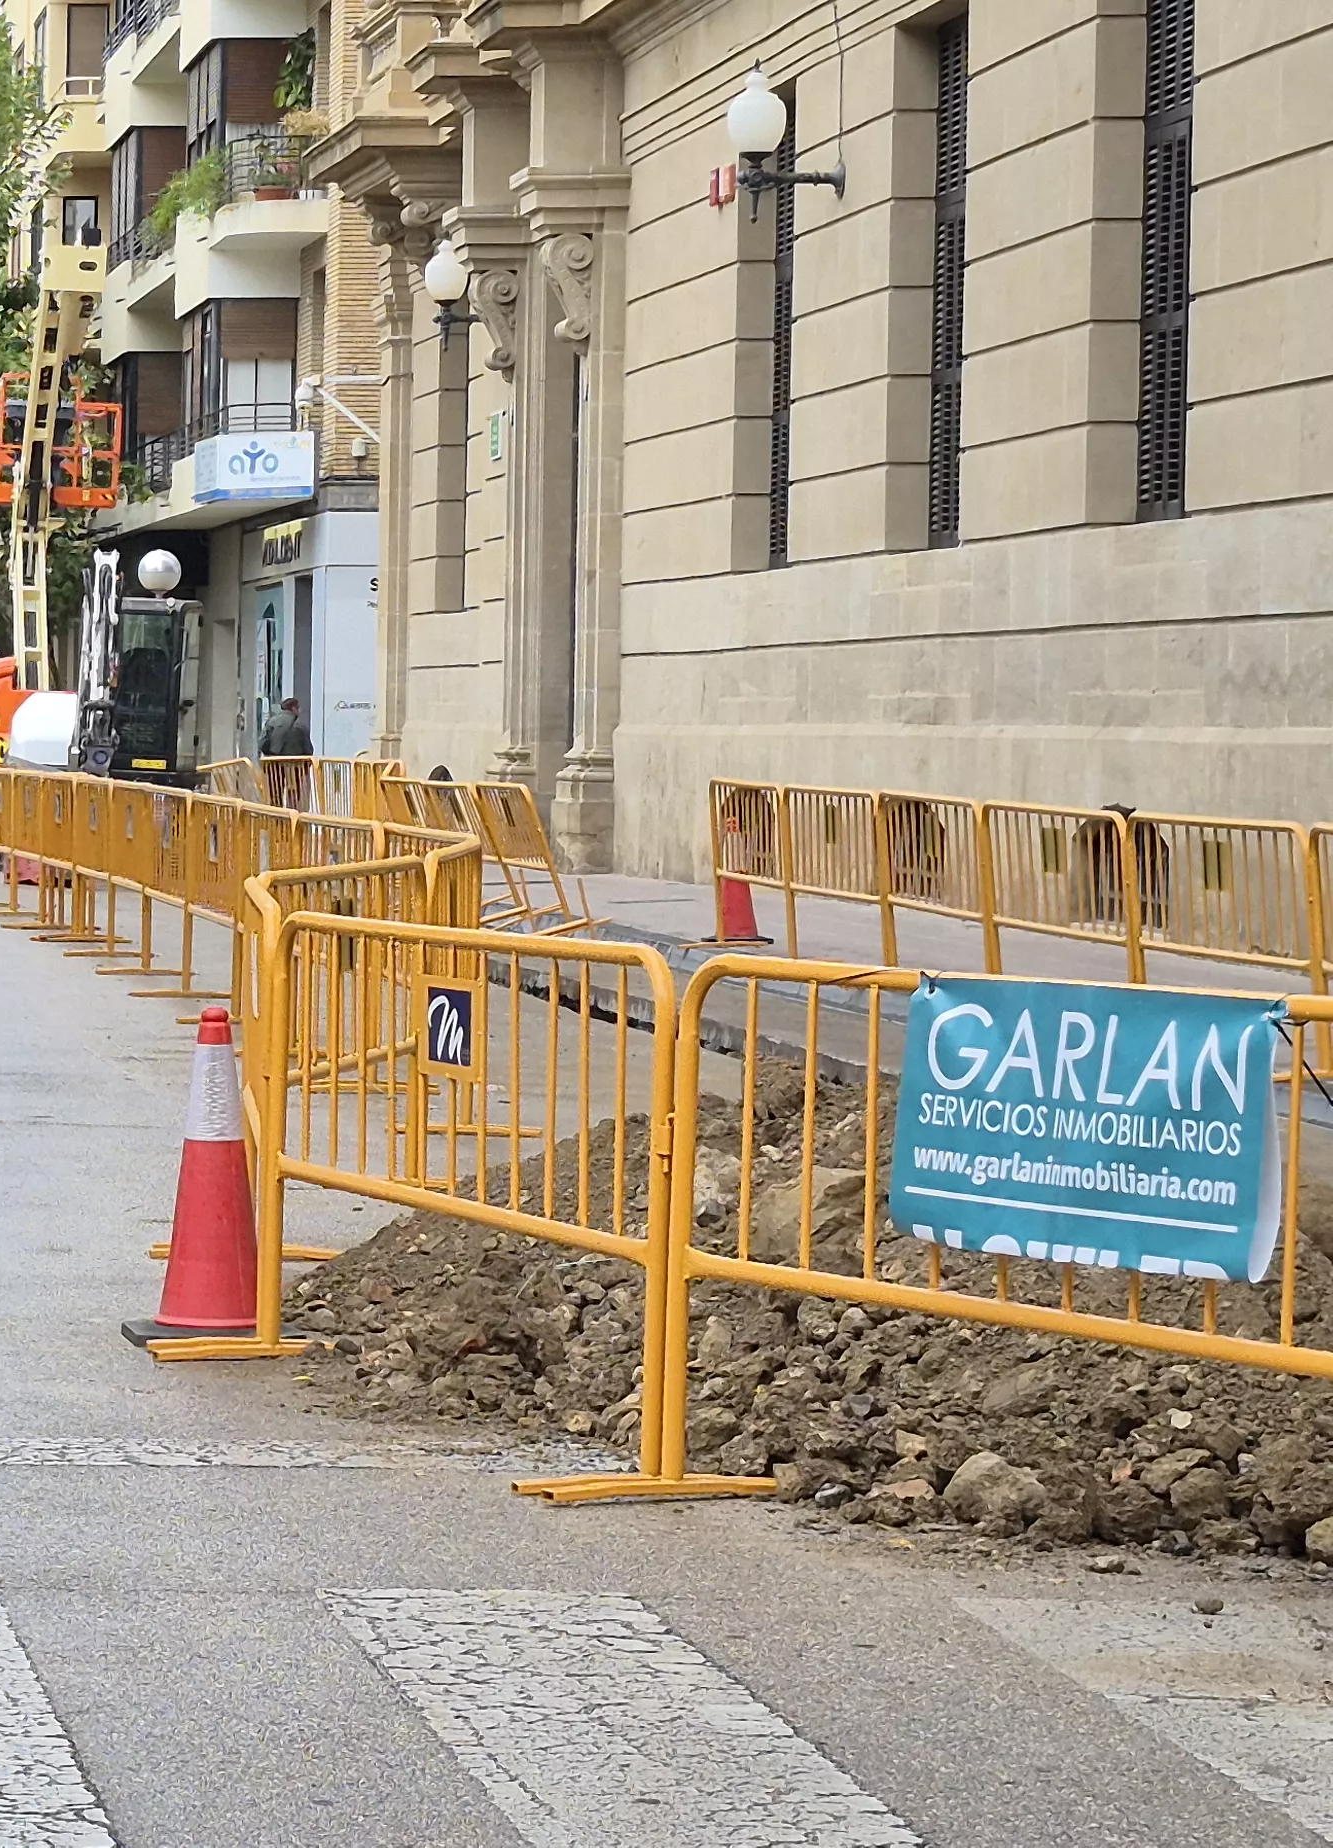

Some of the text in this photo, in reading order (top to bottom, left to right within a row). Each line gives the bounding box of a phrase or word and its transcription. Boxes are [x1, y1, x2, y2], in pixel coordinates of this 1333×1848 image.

[927, 1003, 1254, 1114] GARLAN
[918, 1092, 1243, 1157] SERVICIOS INMOBILIARIOS
[913, 1145, 1236, 1206] www.garlaninmobiliaria.com
